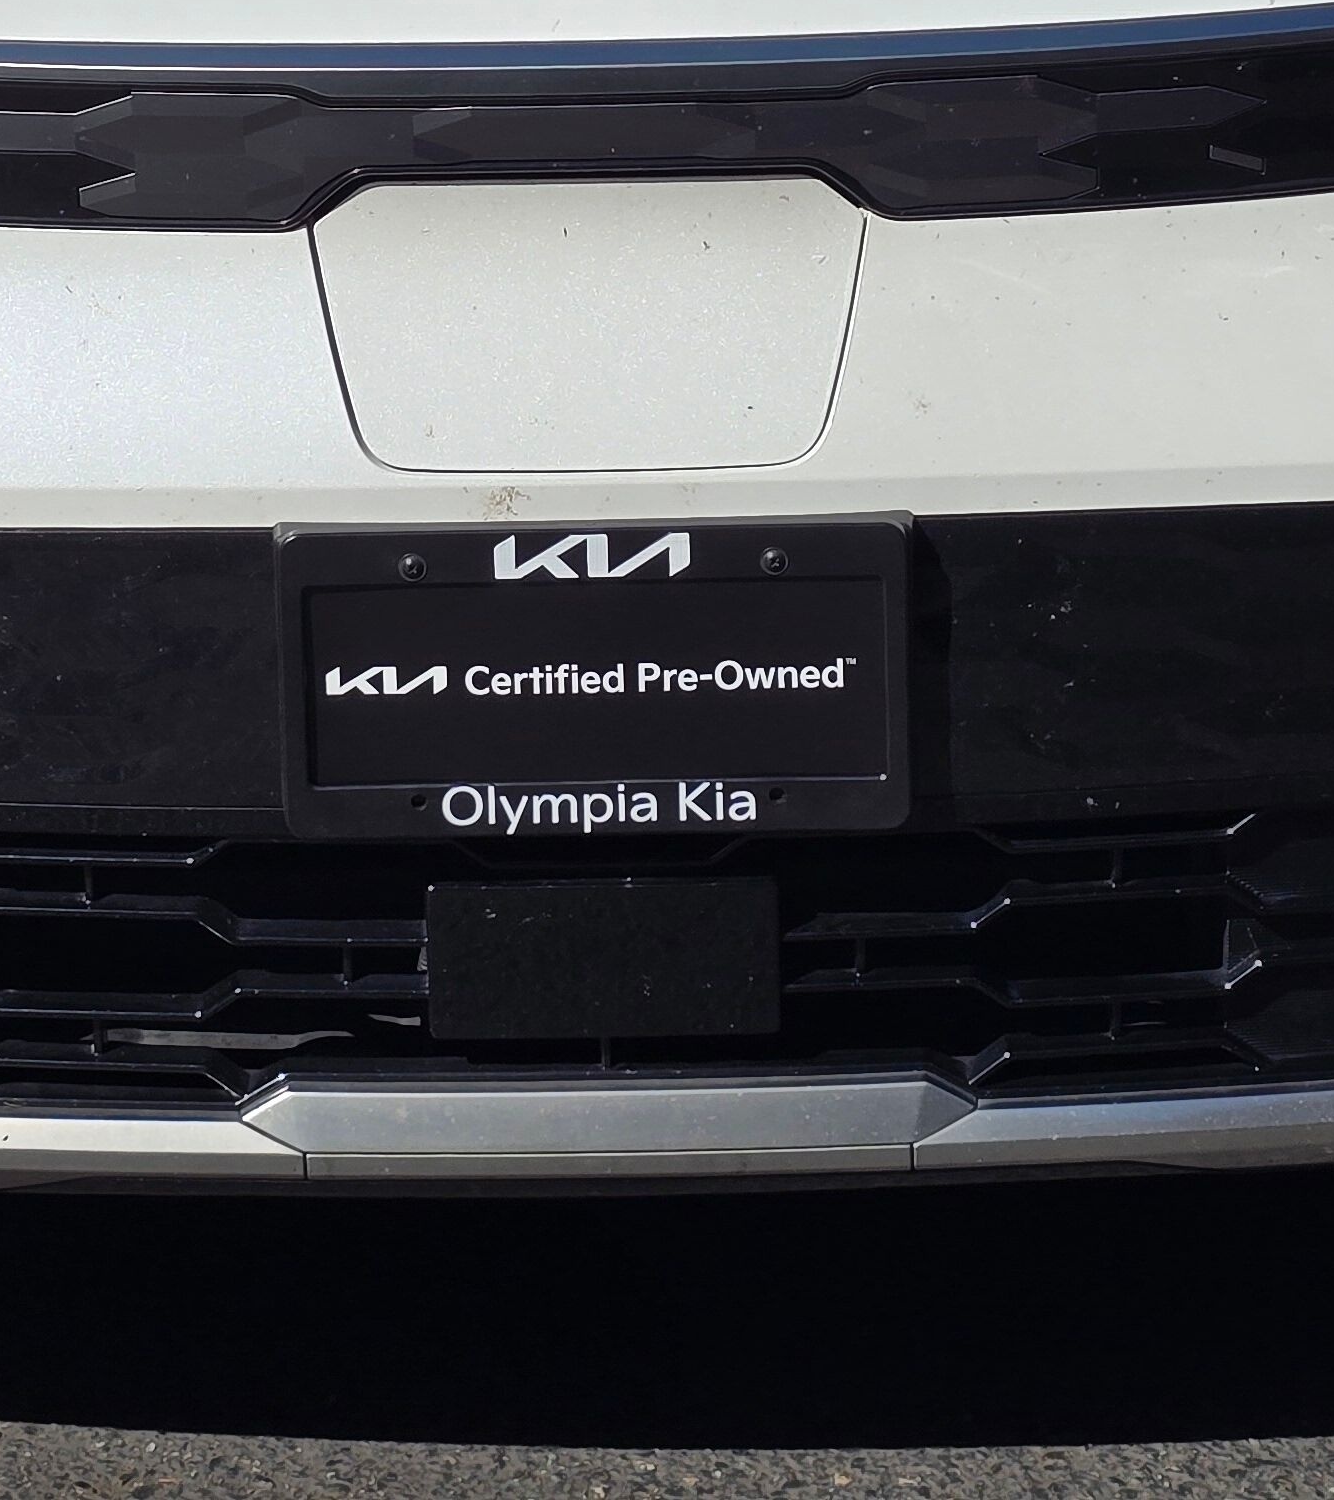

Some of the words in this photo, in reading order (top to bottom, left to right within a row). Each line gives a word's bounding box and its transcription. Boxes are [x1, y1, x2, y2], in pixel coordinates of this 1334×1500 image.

[464, 662, 625, 696] Certified
[441, 783, 658, 835] Olympia
[677, 781, 757, 823] Kia
